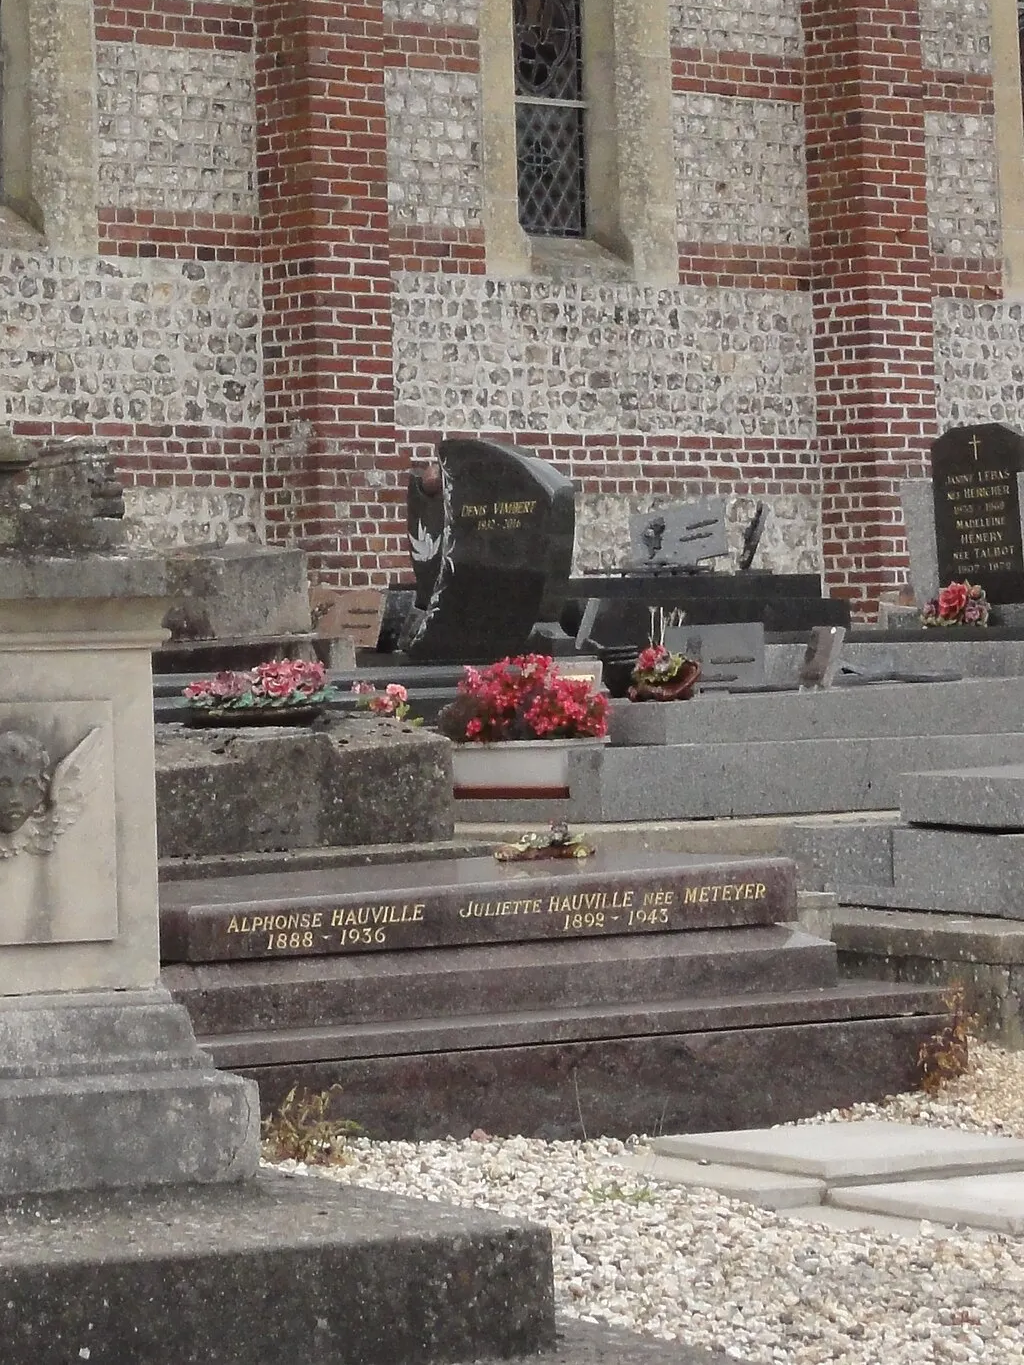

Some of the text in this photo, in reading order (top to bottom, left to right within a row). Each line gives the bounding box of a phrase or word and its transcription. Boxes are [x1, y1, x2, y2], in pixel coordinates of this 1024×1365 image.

[461, 505, 488, 517] DENIS
[974, 545, 1014, 559] TALBOT
[459, 883, 767, 918] JULIETTE HAUVILLE NÉE METEYER
[226, 903, 426, 934] ALPHONSE HAUVILLE
[563, 913, 605, 930] 1892
[627, 909, 669, 925] 1943
[266, 930, 314, 950] 1888
[339, 927, 387, 946] 1936
